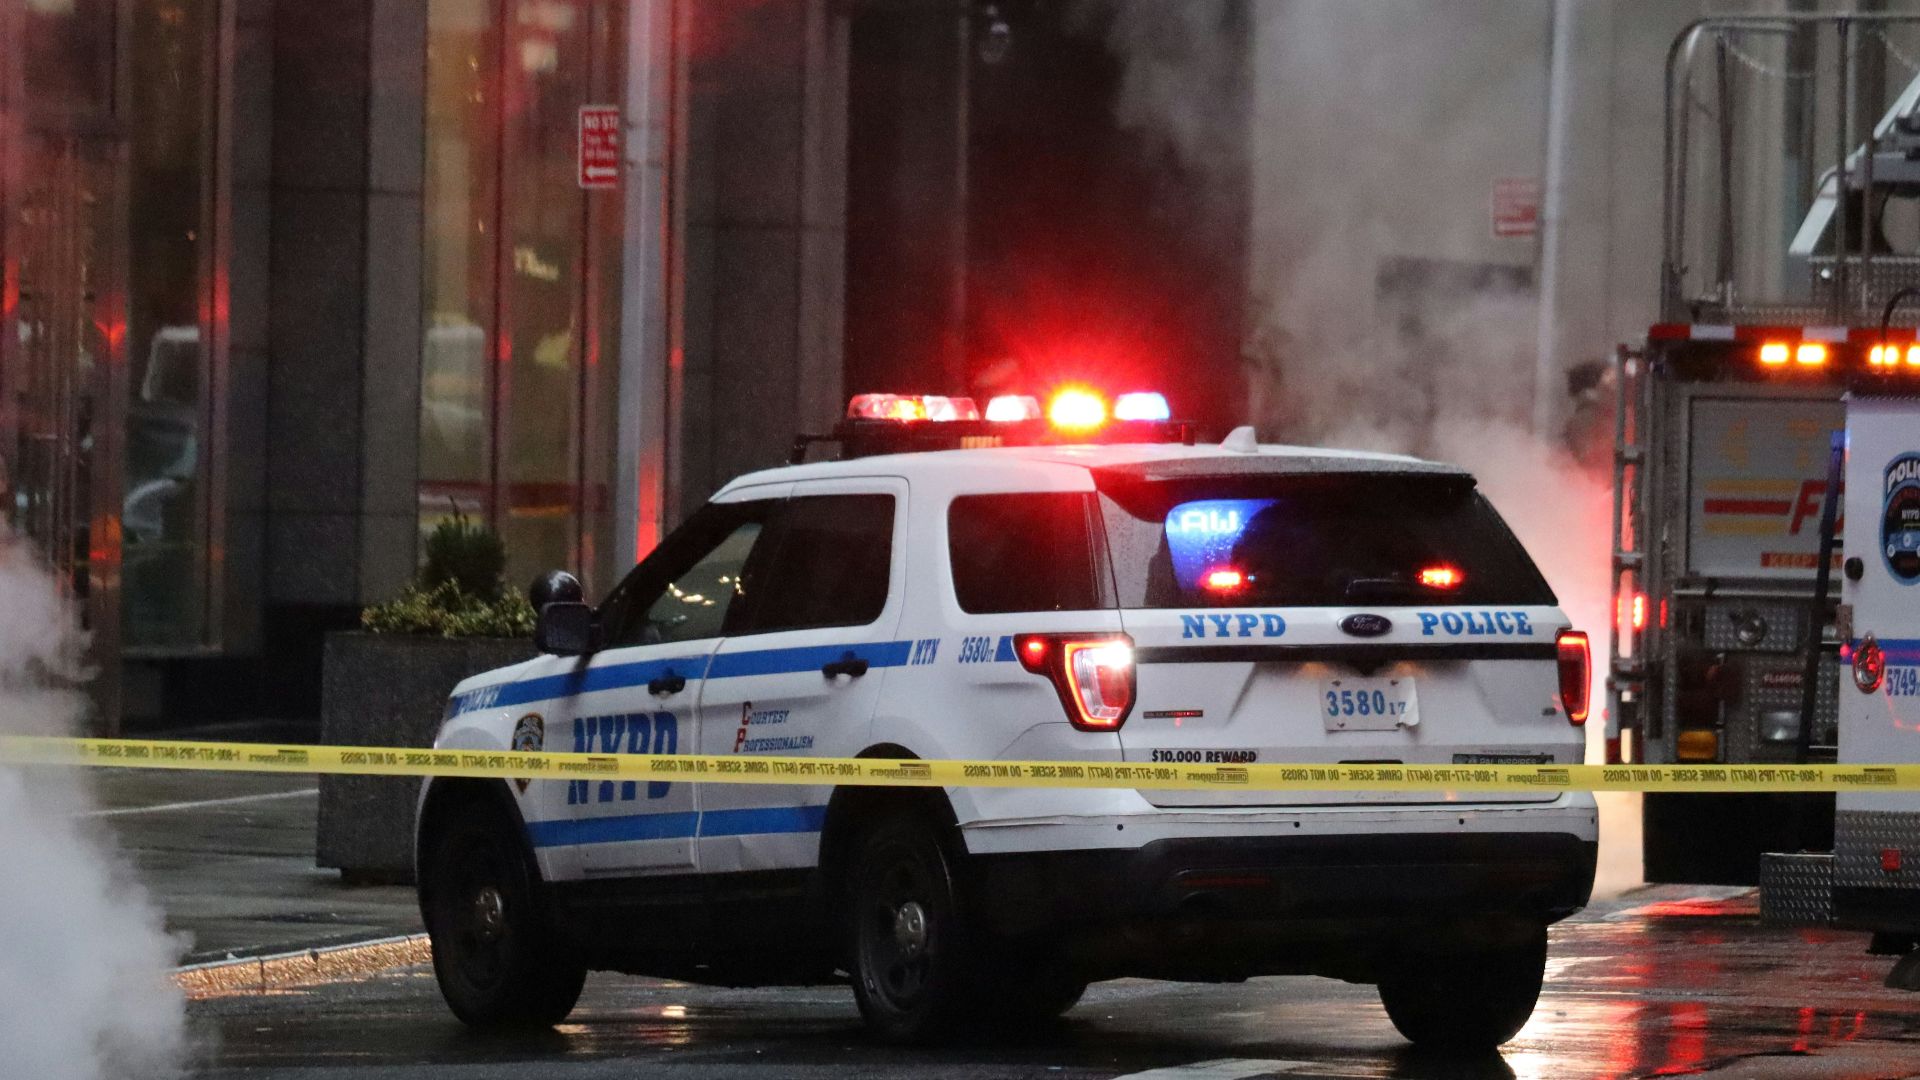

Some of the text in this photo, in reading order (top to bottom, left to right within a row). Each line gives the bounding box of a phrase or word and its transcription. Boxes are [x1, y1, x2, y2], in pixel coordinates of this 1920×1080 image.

[1180, 611, 1533, 638] NYPD POLICE
[911, 638, 941, 666] MTN
[1327, 690, 1386, 716] 3580
[567, 711, 678, 805] NYPD
[1152, 749, 1257, 763] $10,000 REWARD
